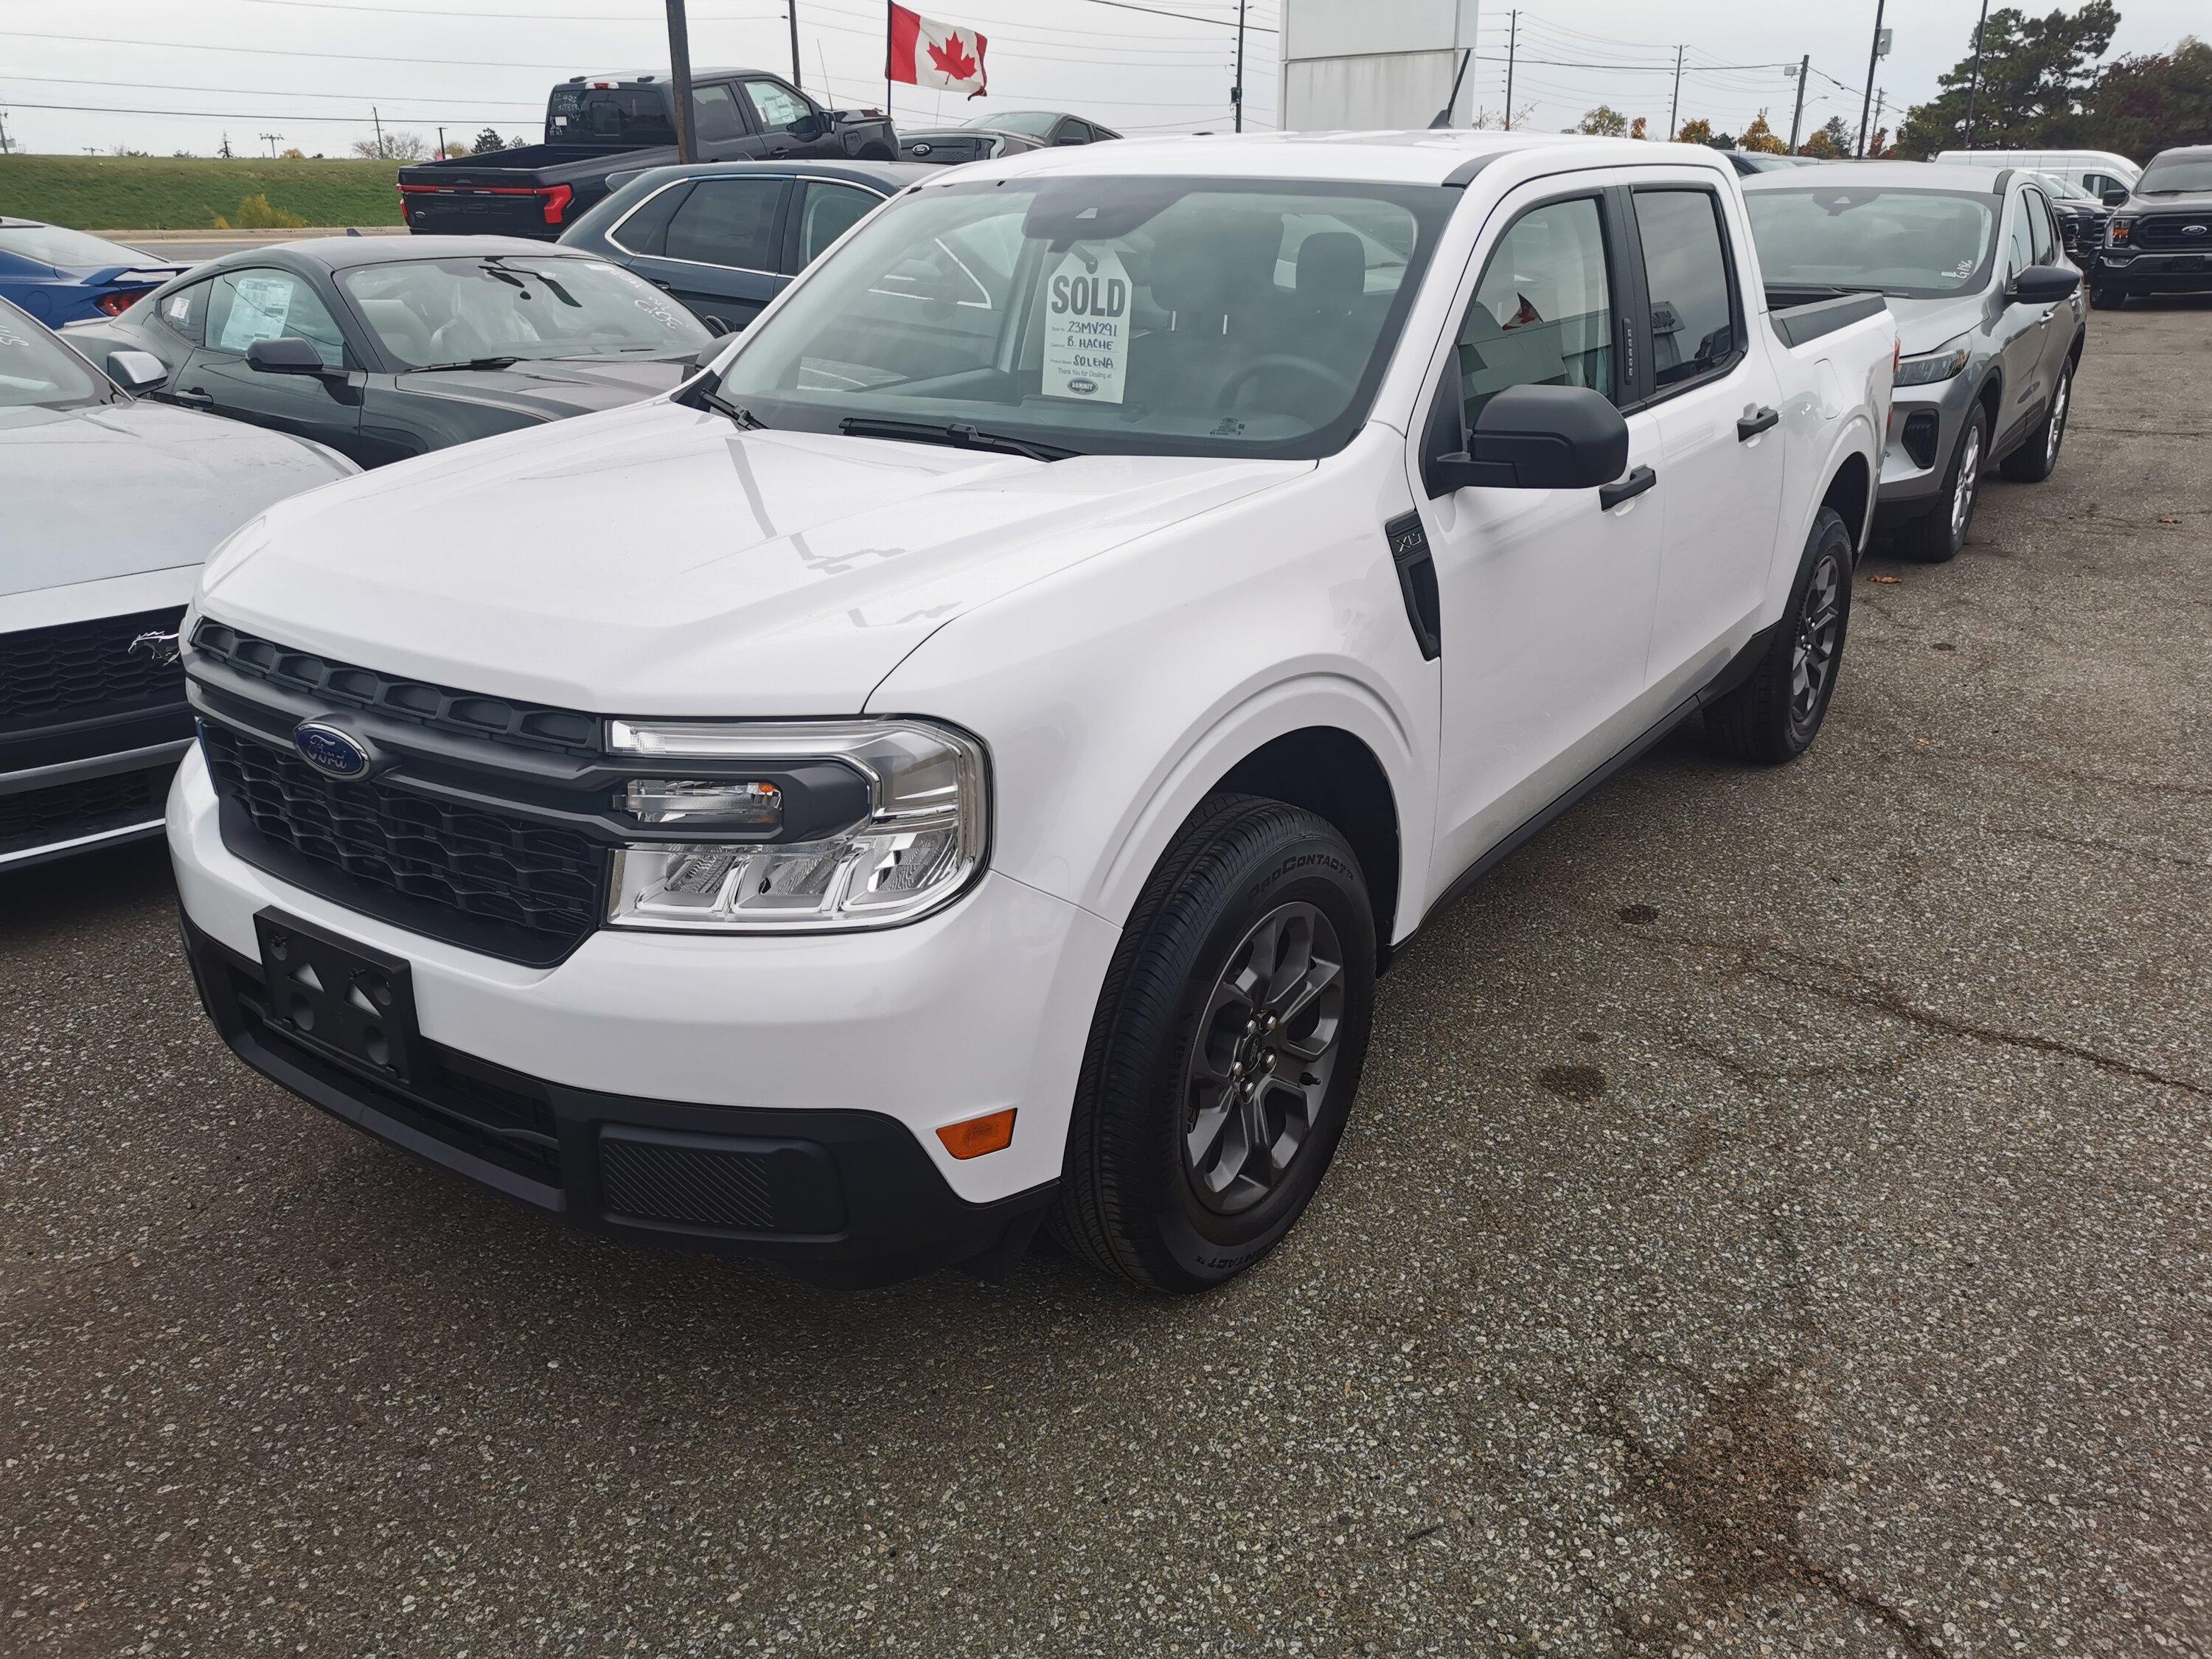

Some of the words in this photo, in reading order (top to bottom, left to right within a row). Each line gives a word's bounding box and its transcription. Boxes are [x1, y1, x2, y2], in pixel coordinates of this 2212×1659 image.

[1051, 275, 1126, 318] SOLD
[1067, 321, 1117, 337] 23MV291
[1079, 338, 1114, 350] HACHE
[1073, 354, 1113, 369] SOLENA
[1089, 370, 1106, 379] Dealing
[307, 734, 348, 770] Ford
